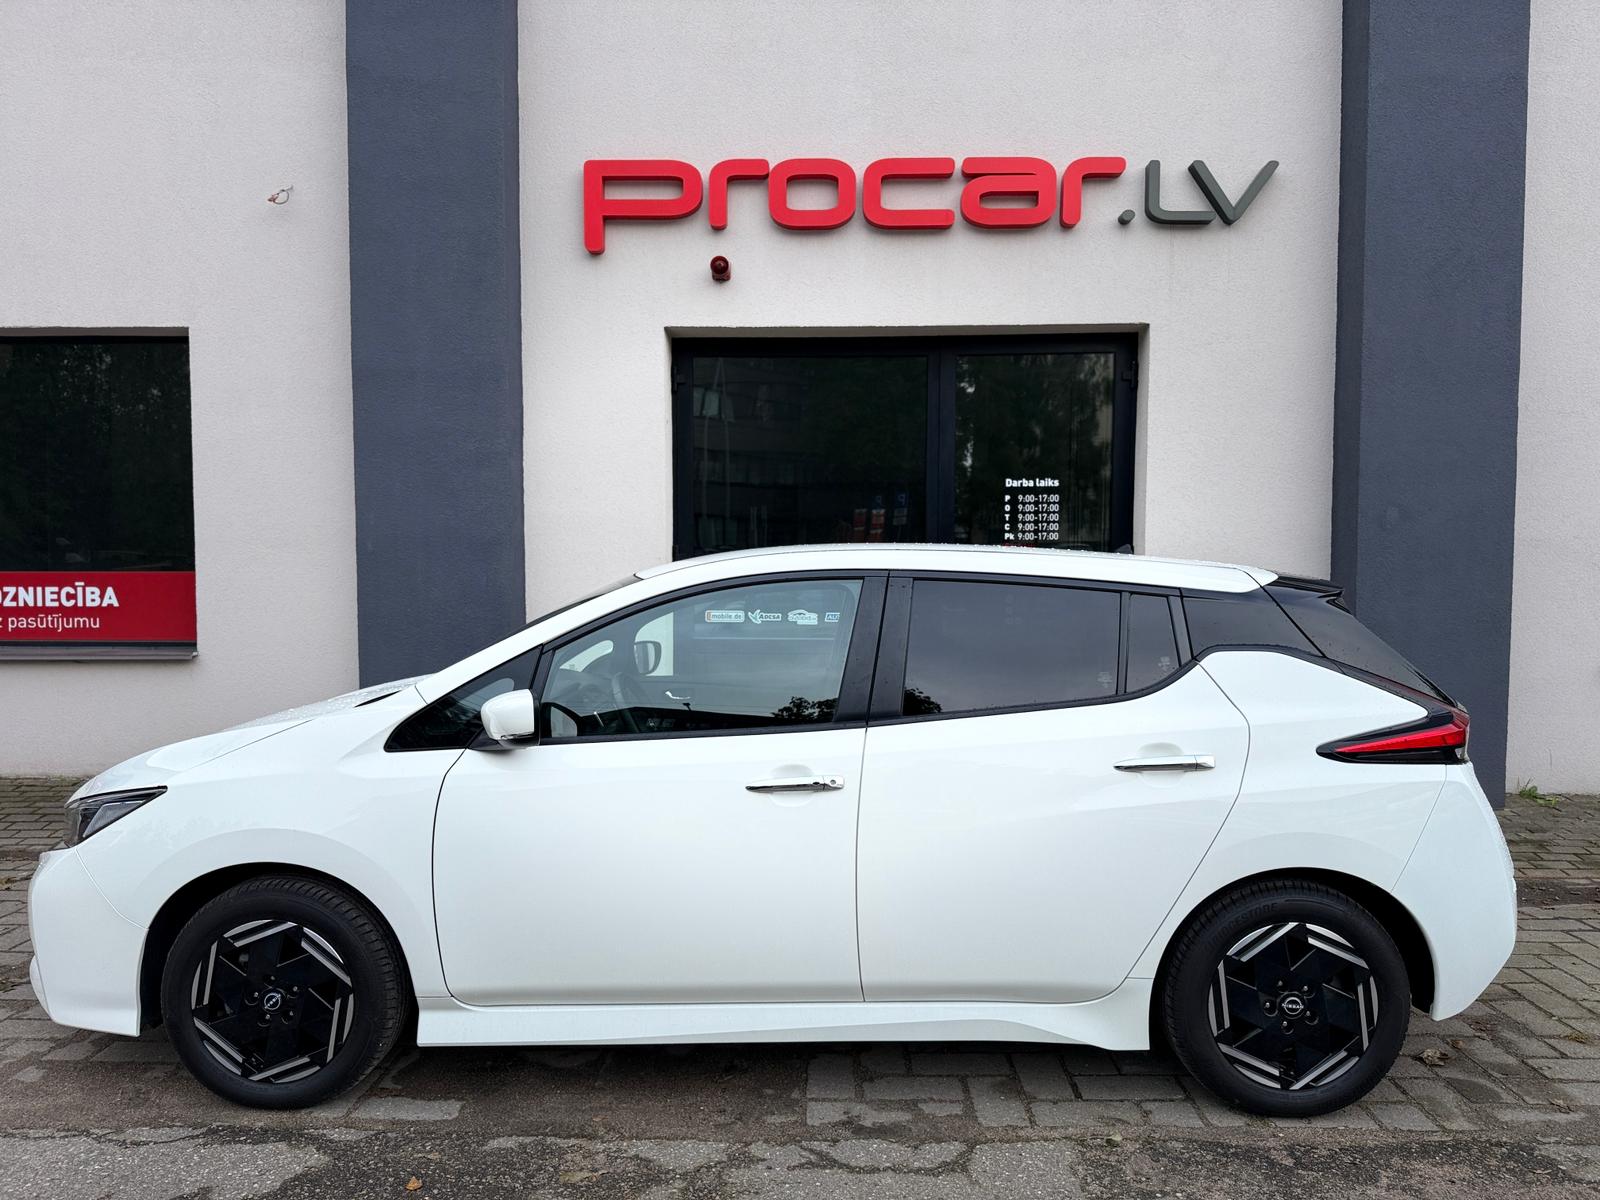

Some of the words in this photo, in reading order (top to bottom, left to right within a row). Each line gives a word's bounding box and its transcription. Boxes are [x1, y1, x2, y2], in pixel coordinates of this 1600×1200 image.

[1005, 478, 1034, 487] Darba
[1035, 478, 1060, 487] laiks
[1004, 494, 1011, 503] P
[1017, 494, 1060, 503] 9:00-17:00
[1017, 504, 1060, 512] 9:00-17:00
[1004, 513, 1011, 522] T
[1017, 513, 1060, 522] 9:00-17:00
[1004, 523, 1011, 531] C
[1017, 523, 1059, 531] 9:00-17:00
[1004, 532, 1015, 541] Pk
[1017, 532, 1059, 541] 9:00-17:00
[0, 582, 120, 607] ZNIECĪBA
[8, 614, 100, 632] pasūtījumu
